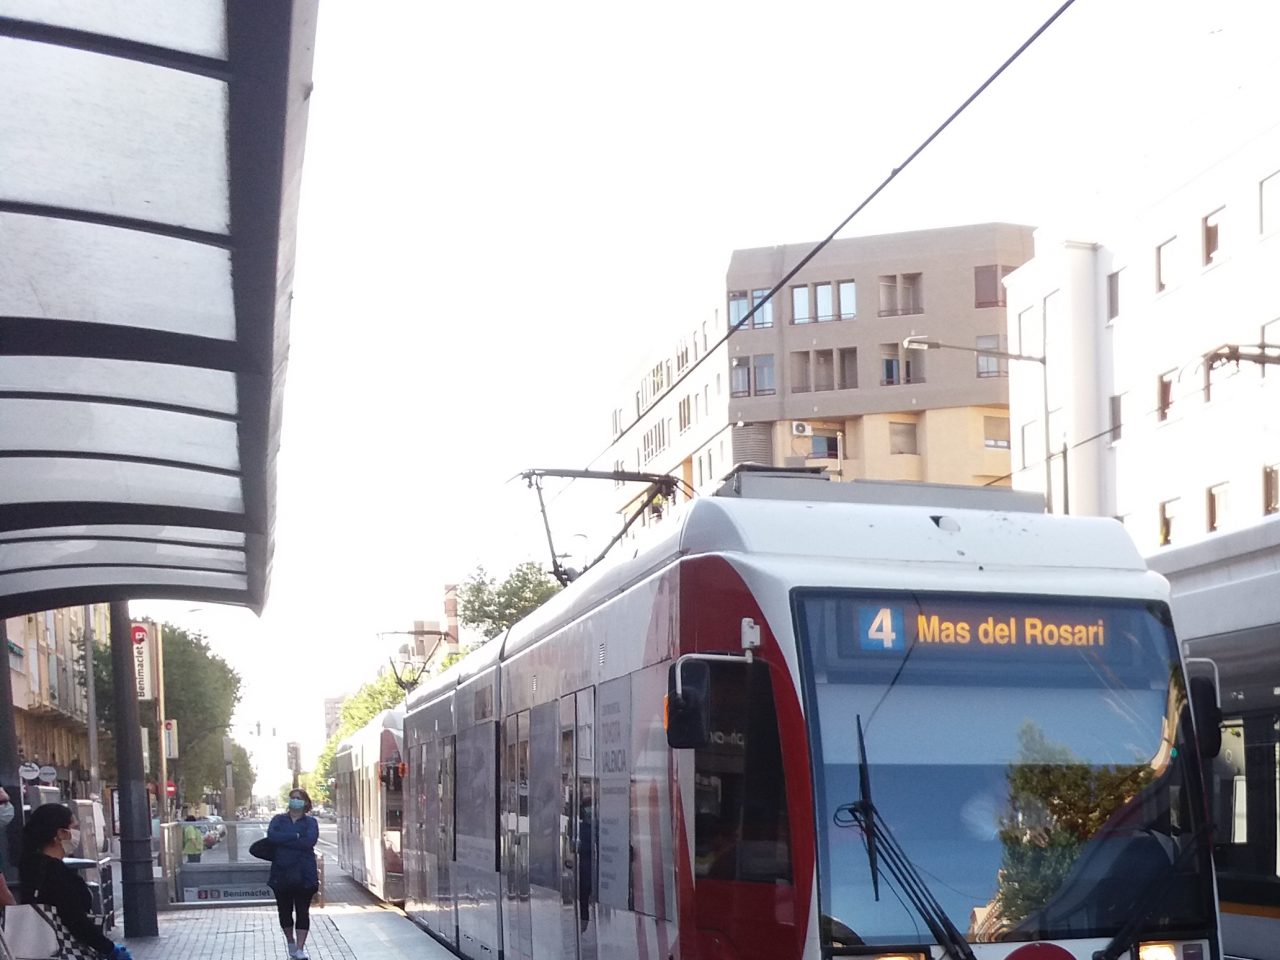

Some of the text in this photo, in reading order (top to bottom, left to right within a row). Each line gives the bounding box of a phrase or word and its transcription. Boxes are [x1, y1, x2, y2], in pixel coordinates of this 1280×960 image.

[867, 607, 1104, 648] 4 Mas del Rosari
[136, 646, 145, 697] Benimaclet
[223, 888, 270, 898] Benimaclet
